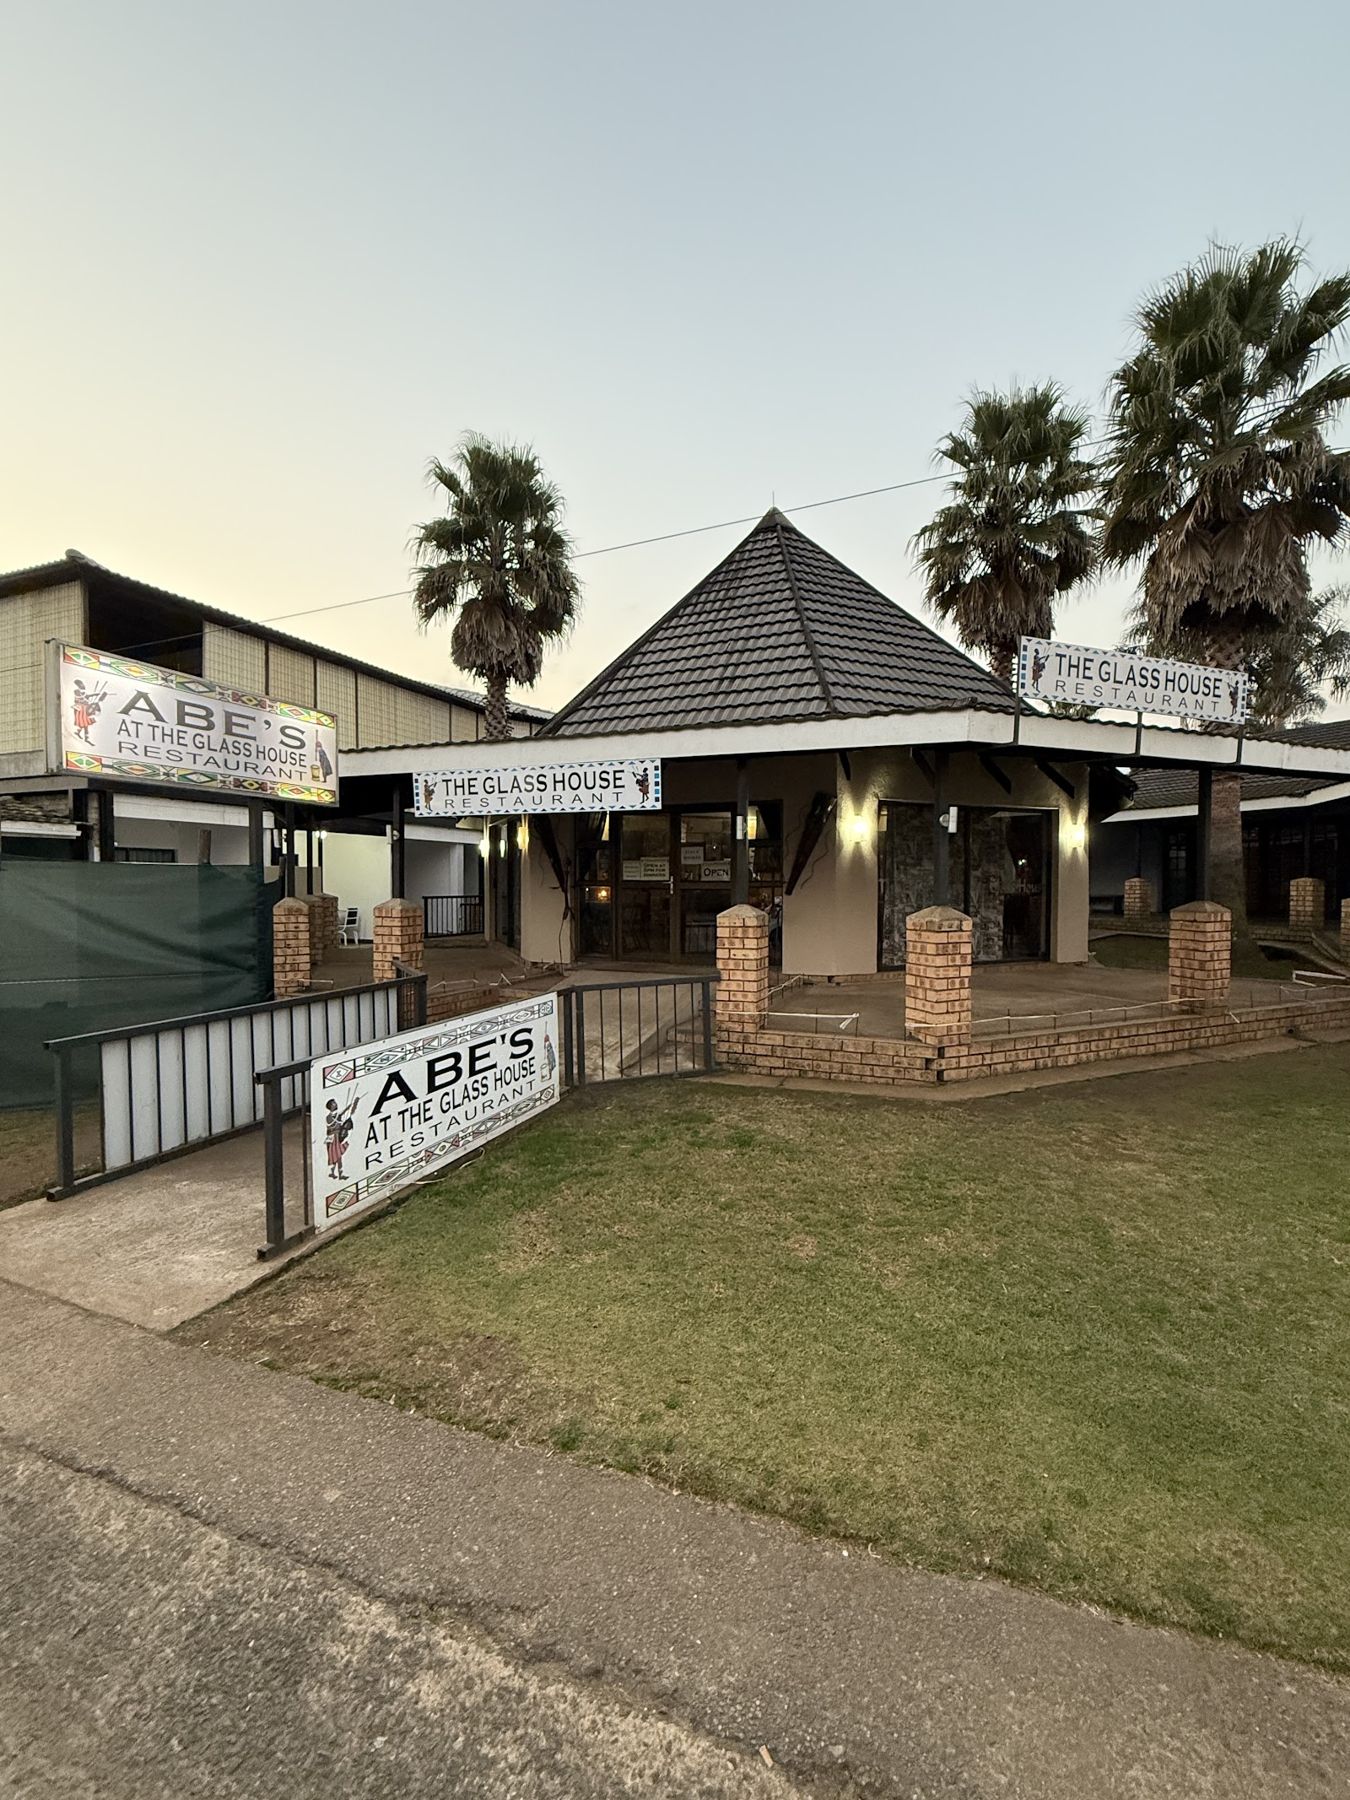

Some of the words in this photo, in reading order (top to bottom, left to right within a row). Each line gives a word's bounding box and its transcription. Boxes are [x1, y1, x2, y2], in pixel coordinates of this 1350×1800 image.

[1055, 652, 1094, 680] THE
[1098, 660, 1160, 690] GLASS
[1165, 671, 1222, 698] HOUSE
[1055, 679, 1220, 712] RESTAURANT
[116, 688, 307, 750] ABE'S
[116, 718, 143, 739] AT
[147, 723, 188, 747] THE
[192, 733, 252, 758] GLASS
[256, 742, 308, 768] HOUSE
[118, 741, 308, 781] RESTAURANT
[442, 777, 479, 796] THE
[482, 773, 548, 795] GLASS
[553, 769, 625, 792] HOUSE
[444, 792, 624, 809] RESTAURANT
[368, 1027, 534, 1118] ABE'S
[364, 1116, 391, 1149] AT
[397, 1098, 433, 1132] THE
[439, 1076, 489, 1114] GLASS
[493, 1057, 536, 1092] HOUSE
[364, 1079, 536, 1170] RESTAURANT
